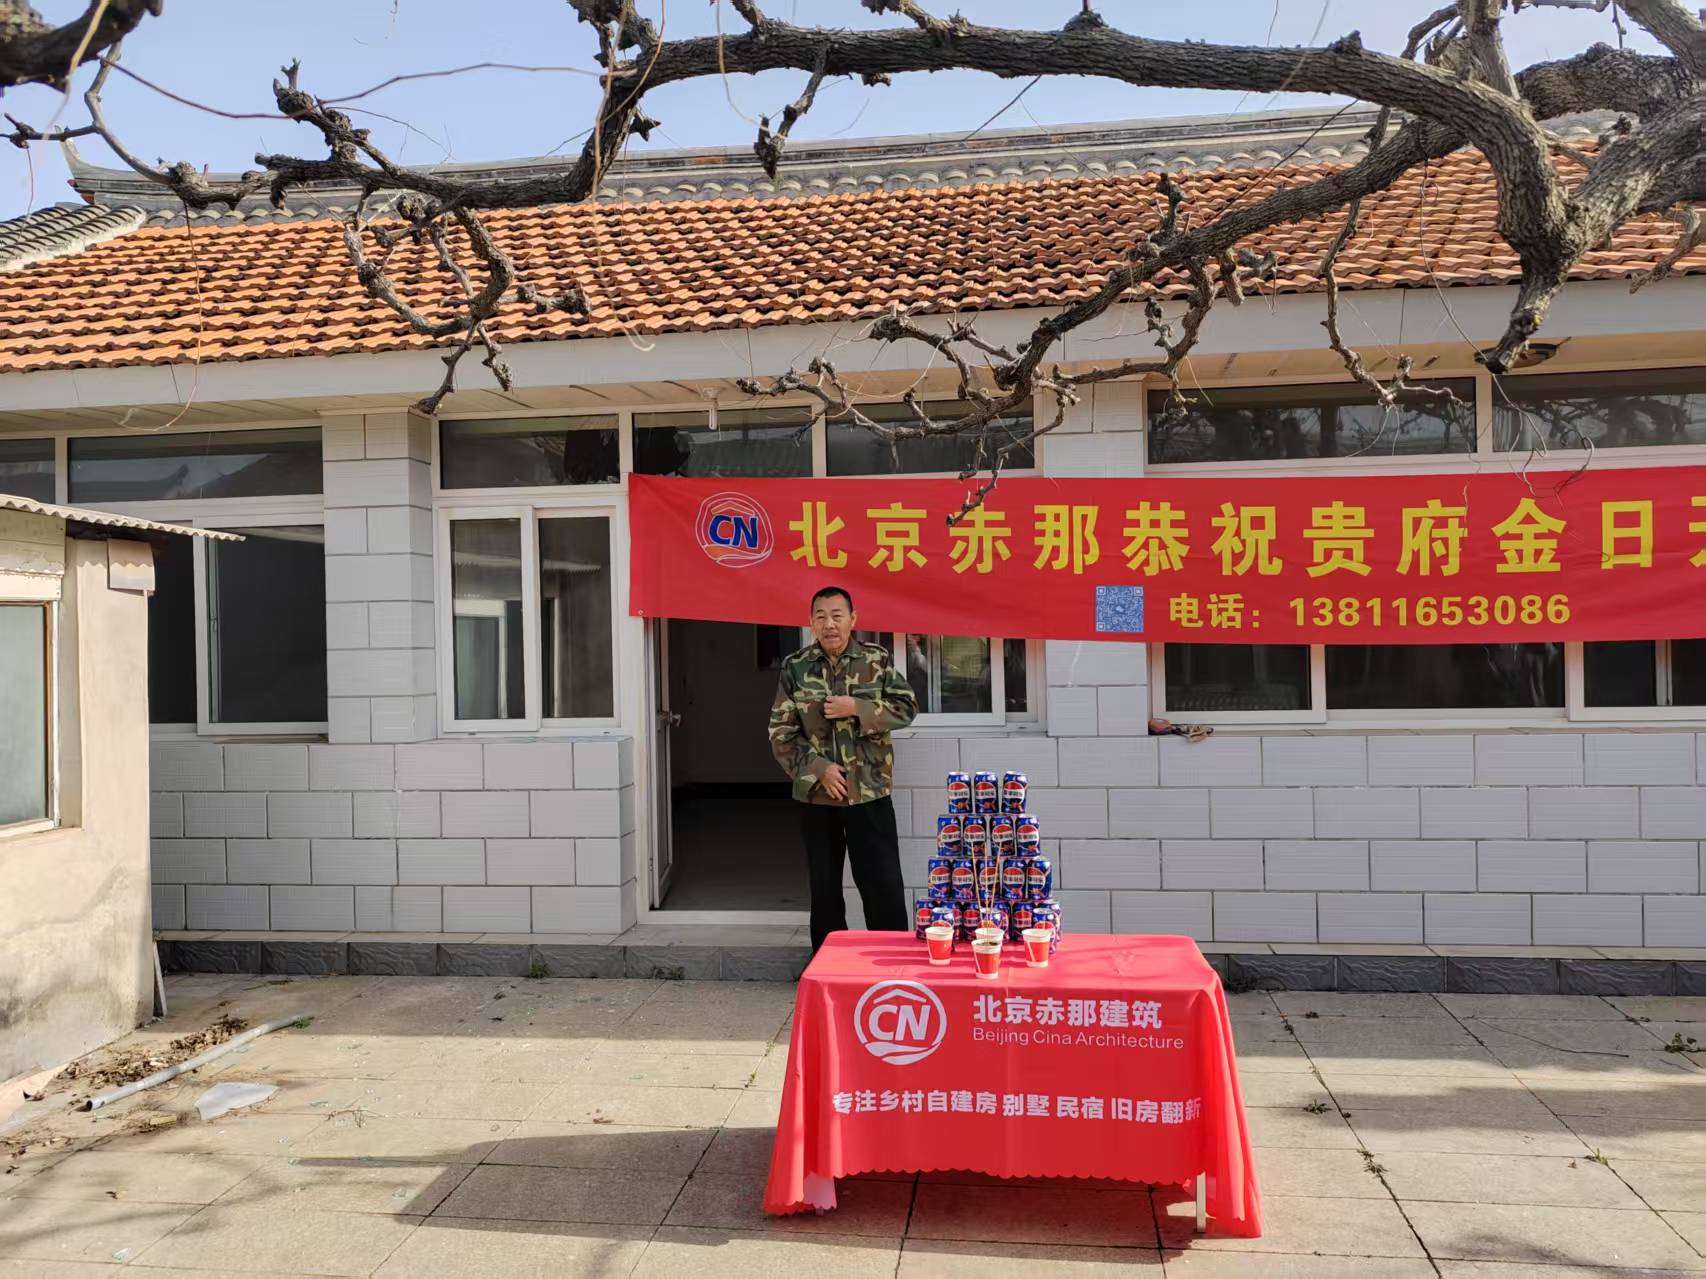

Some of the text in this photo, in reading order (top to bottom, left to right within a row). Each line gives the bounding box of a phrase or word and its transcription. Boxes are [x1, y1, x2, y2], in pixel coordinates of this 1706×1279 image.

[709, 515, 758, 549] CN
[788, 496, 1706, 577] 北京赤那恭祝贵府金日
[868, 1004, 931, 1041] CN
[972, 995, 1163, 1029] 北京赤那建筑
[972, 1027, 1184, 1049] Beijing Cina Architecture
[832, 1089, 997, 1115] 专注乡村自建房
[1002, 1093, 1050, 1117] 别墅
[1056, 1096, 1105, 1120] 民宿
